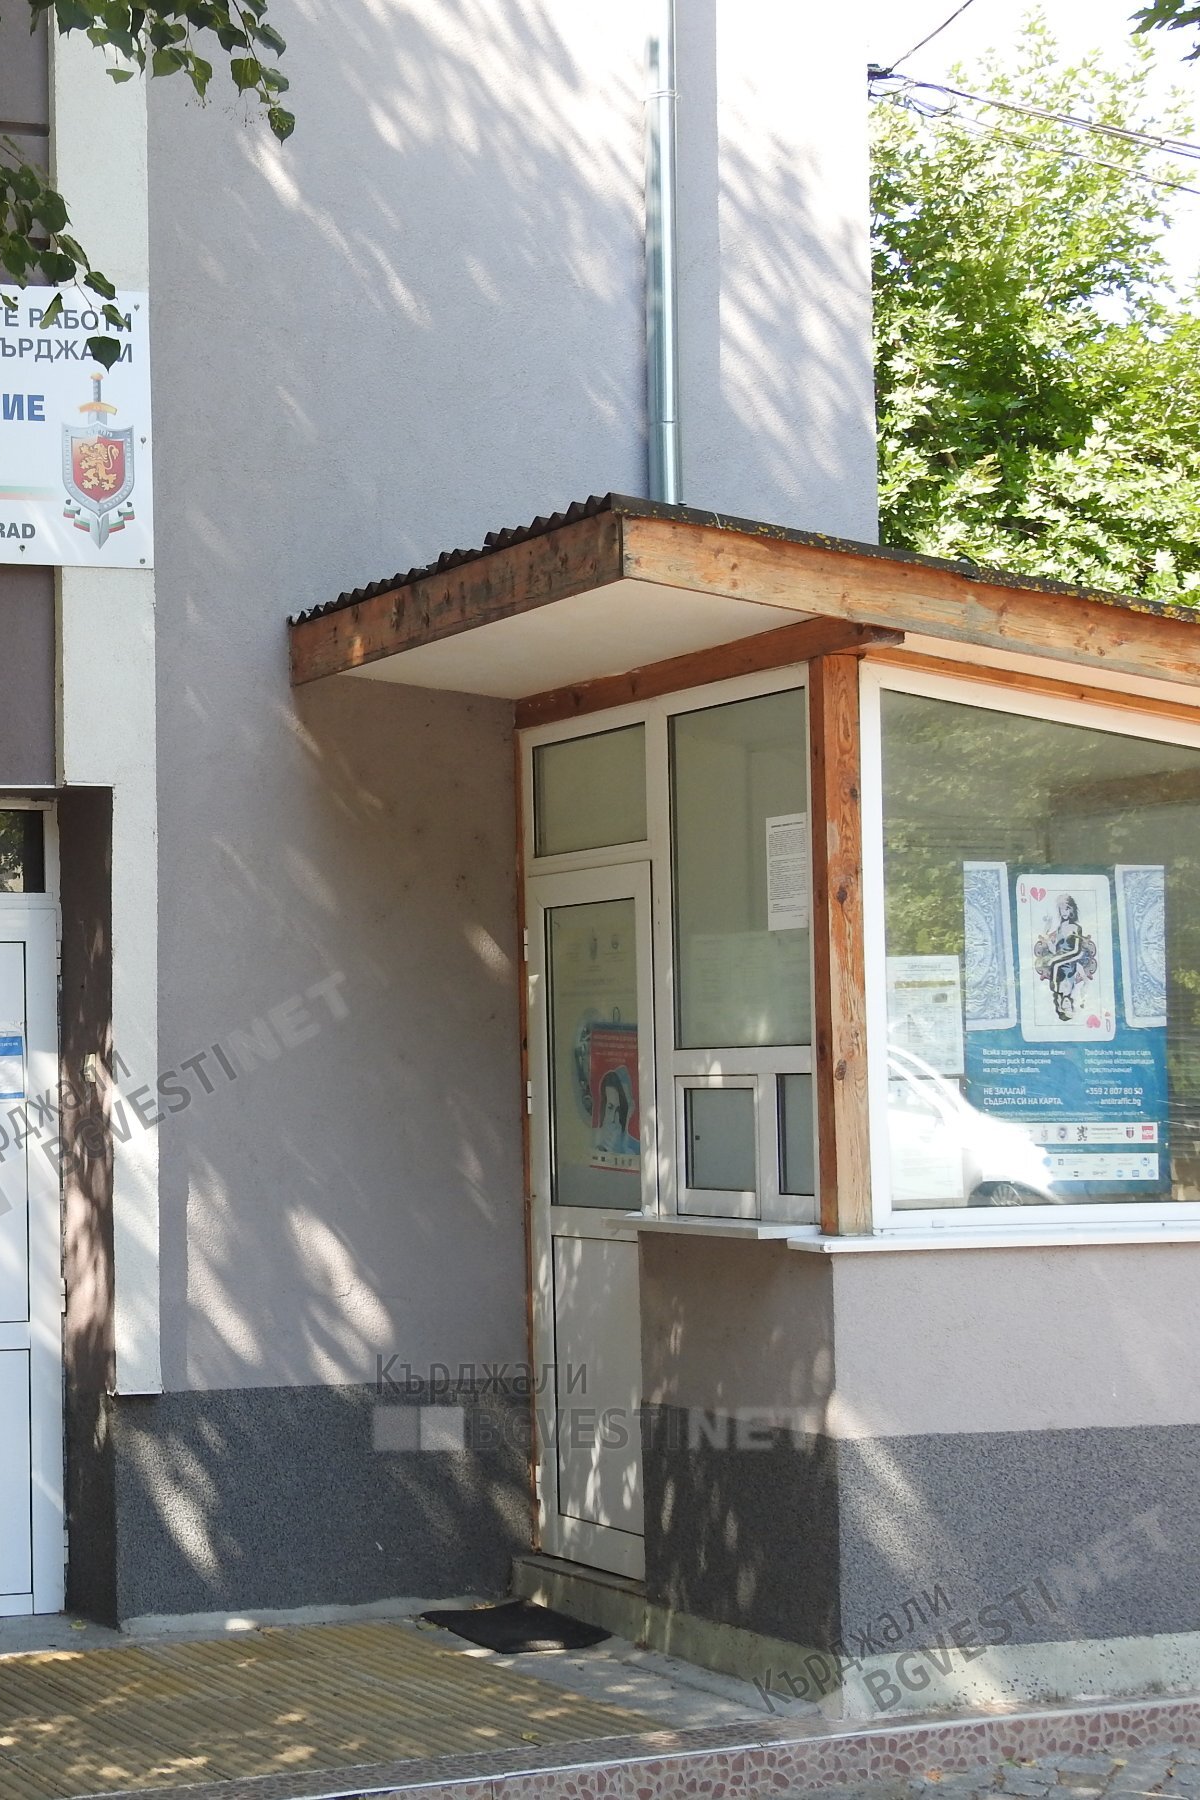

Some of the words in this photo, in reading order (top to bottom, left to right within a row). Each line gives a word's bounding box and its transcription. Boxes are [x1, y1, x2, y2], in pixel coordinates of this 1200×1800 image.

[983, 1087, 994, 1095] НЕ
[994, 1086, 1026, 1095] ЗАЛАГАЙ
[983, 1097, 1016, 1106] СЪДБАТА
[1016, 1097, 1027, 1105] СИ
[1027, 1097, 1038, 1105] НА
